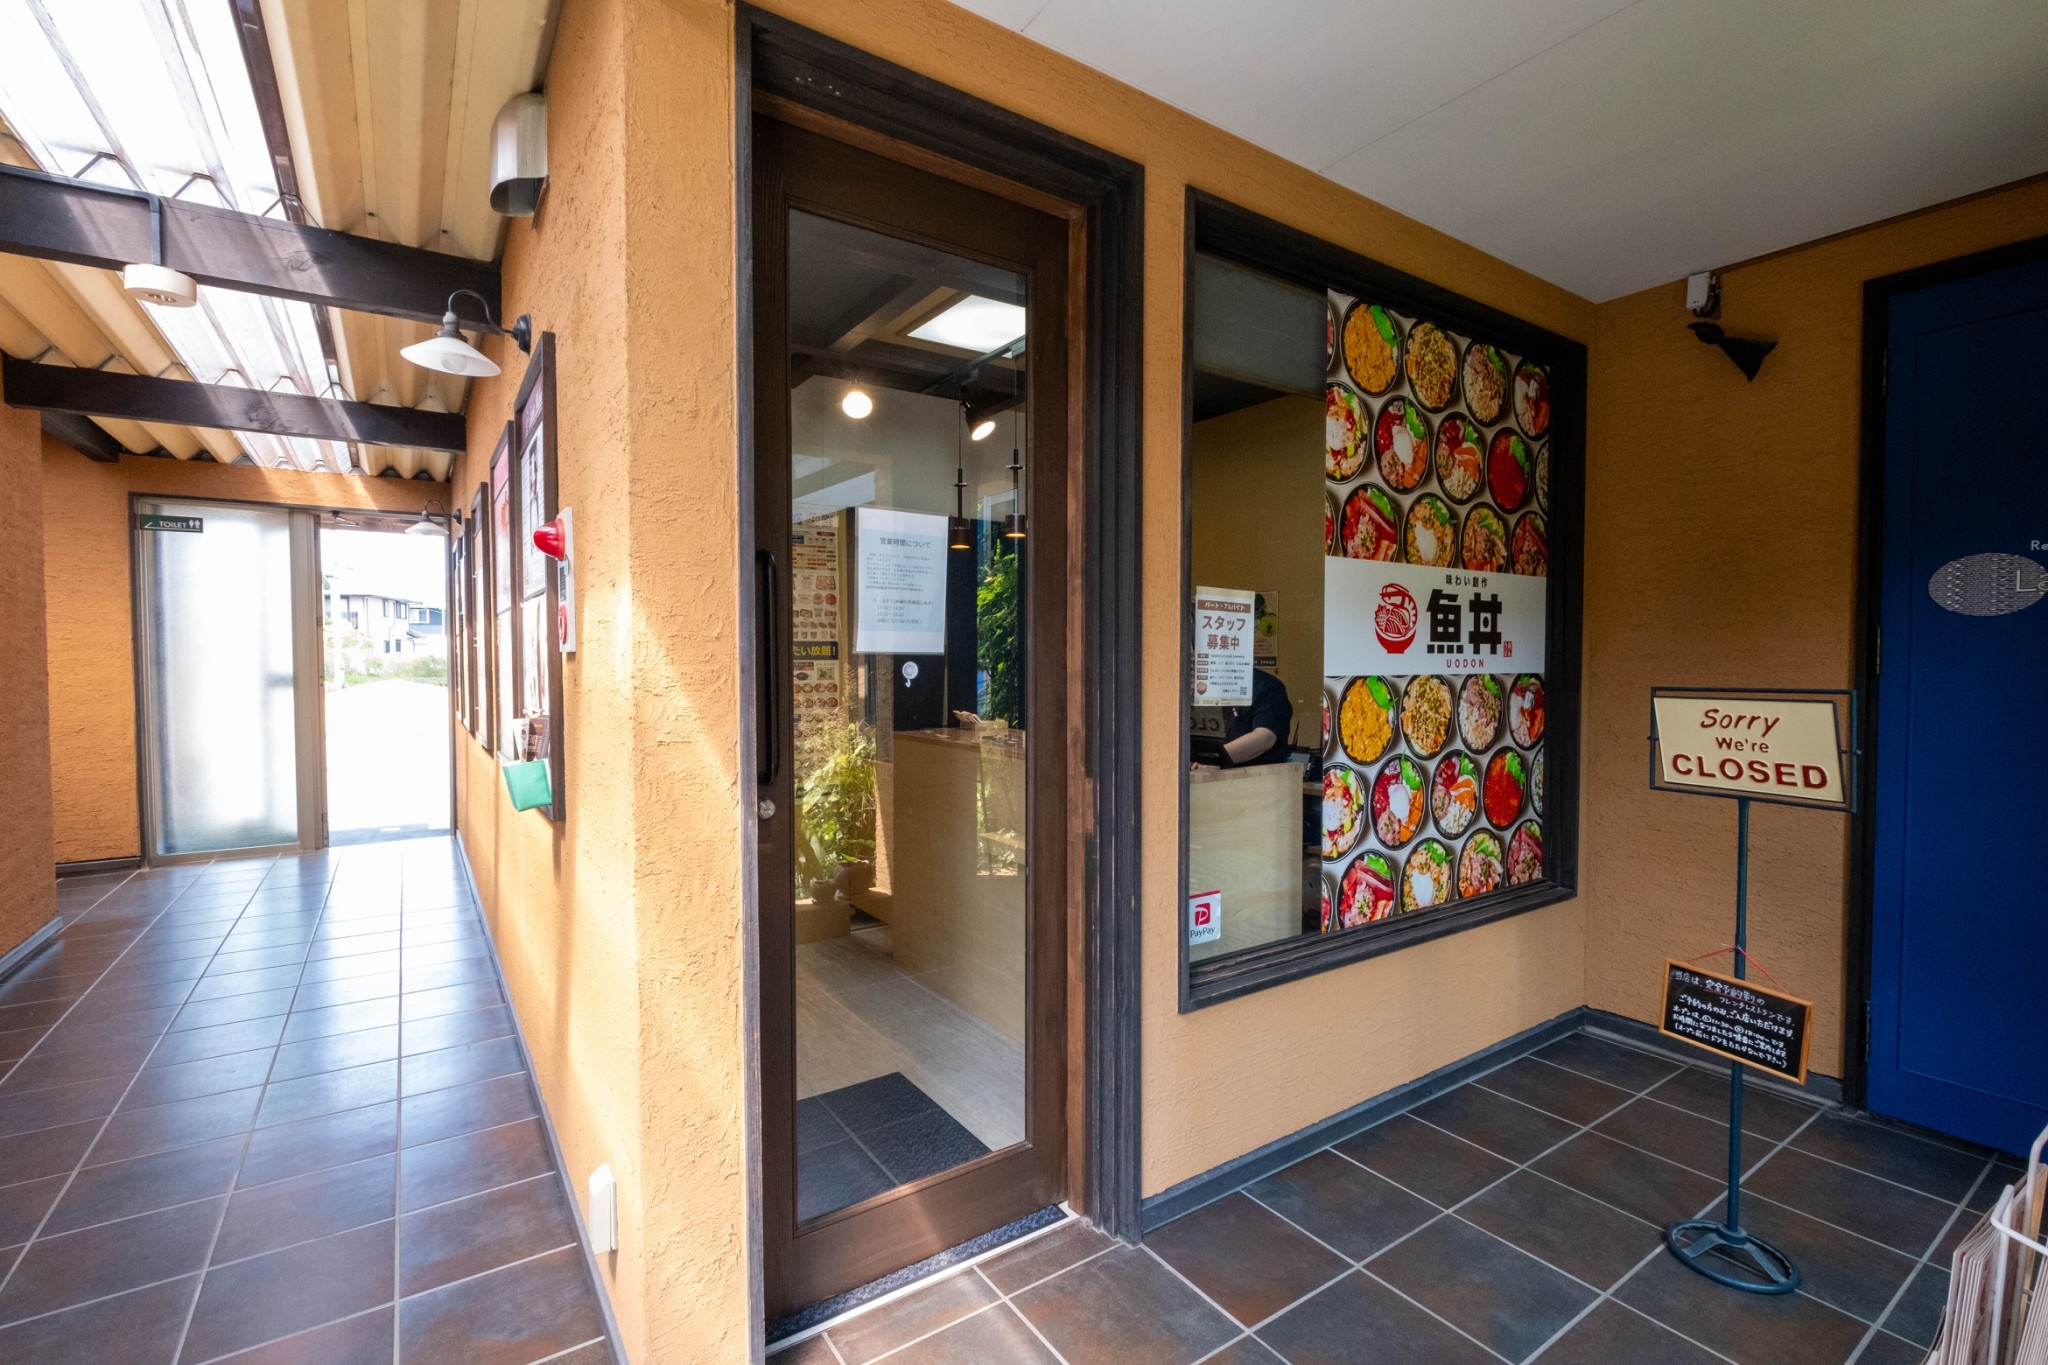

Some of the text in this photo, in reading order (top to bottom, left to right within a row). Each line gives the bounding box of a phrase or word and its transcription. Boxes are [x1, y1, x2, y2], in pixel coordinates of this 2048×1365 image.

[159, 521, 187, 529] TOILET
[880, 537, 931, 549] 営業時間について
[1445, 574, 1488, 589] 味わい創作
[1204, 602, 1245, 611] パート・アルバイト
[1202, 615, 1246, 631] スタッフ
[1426, 588, 1503, 655] 魚丼
[1207, 634, 1240, 651] 募集中
[1446, 658, 1485, 668] UODON
[1700, 708, 1780, 738] Sorry
[1715, 736, 1770, 753] We're
[1672, 753, 1828, 789] CLOSED
[1190, 926, 1216, 938] PayPay
